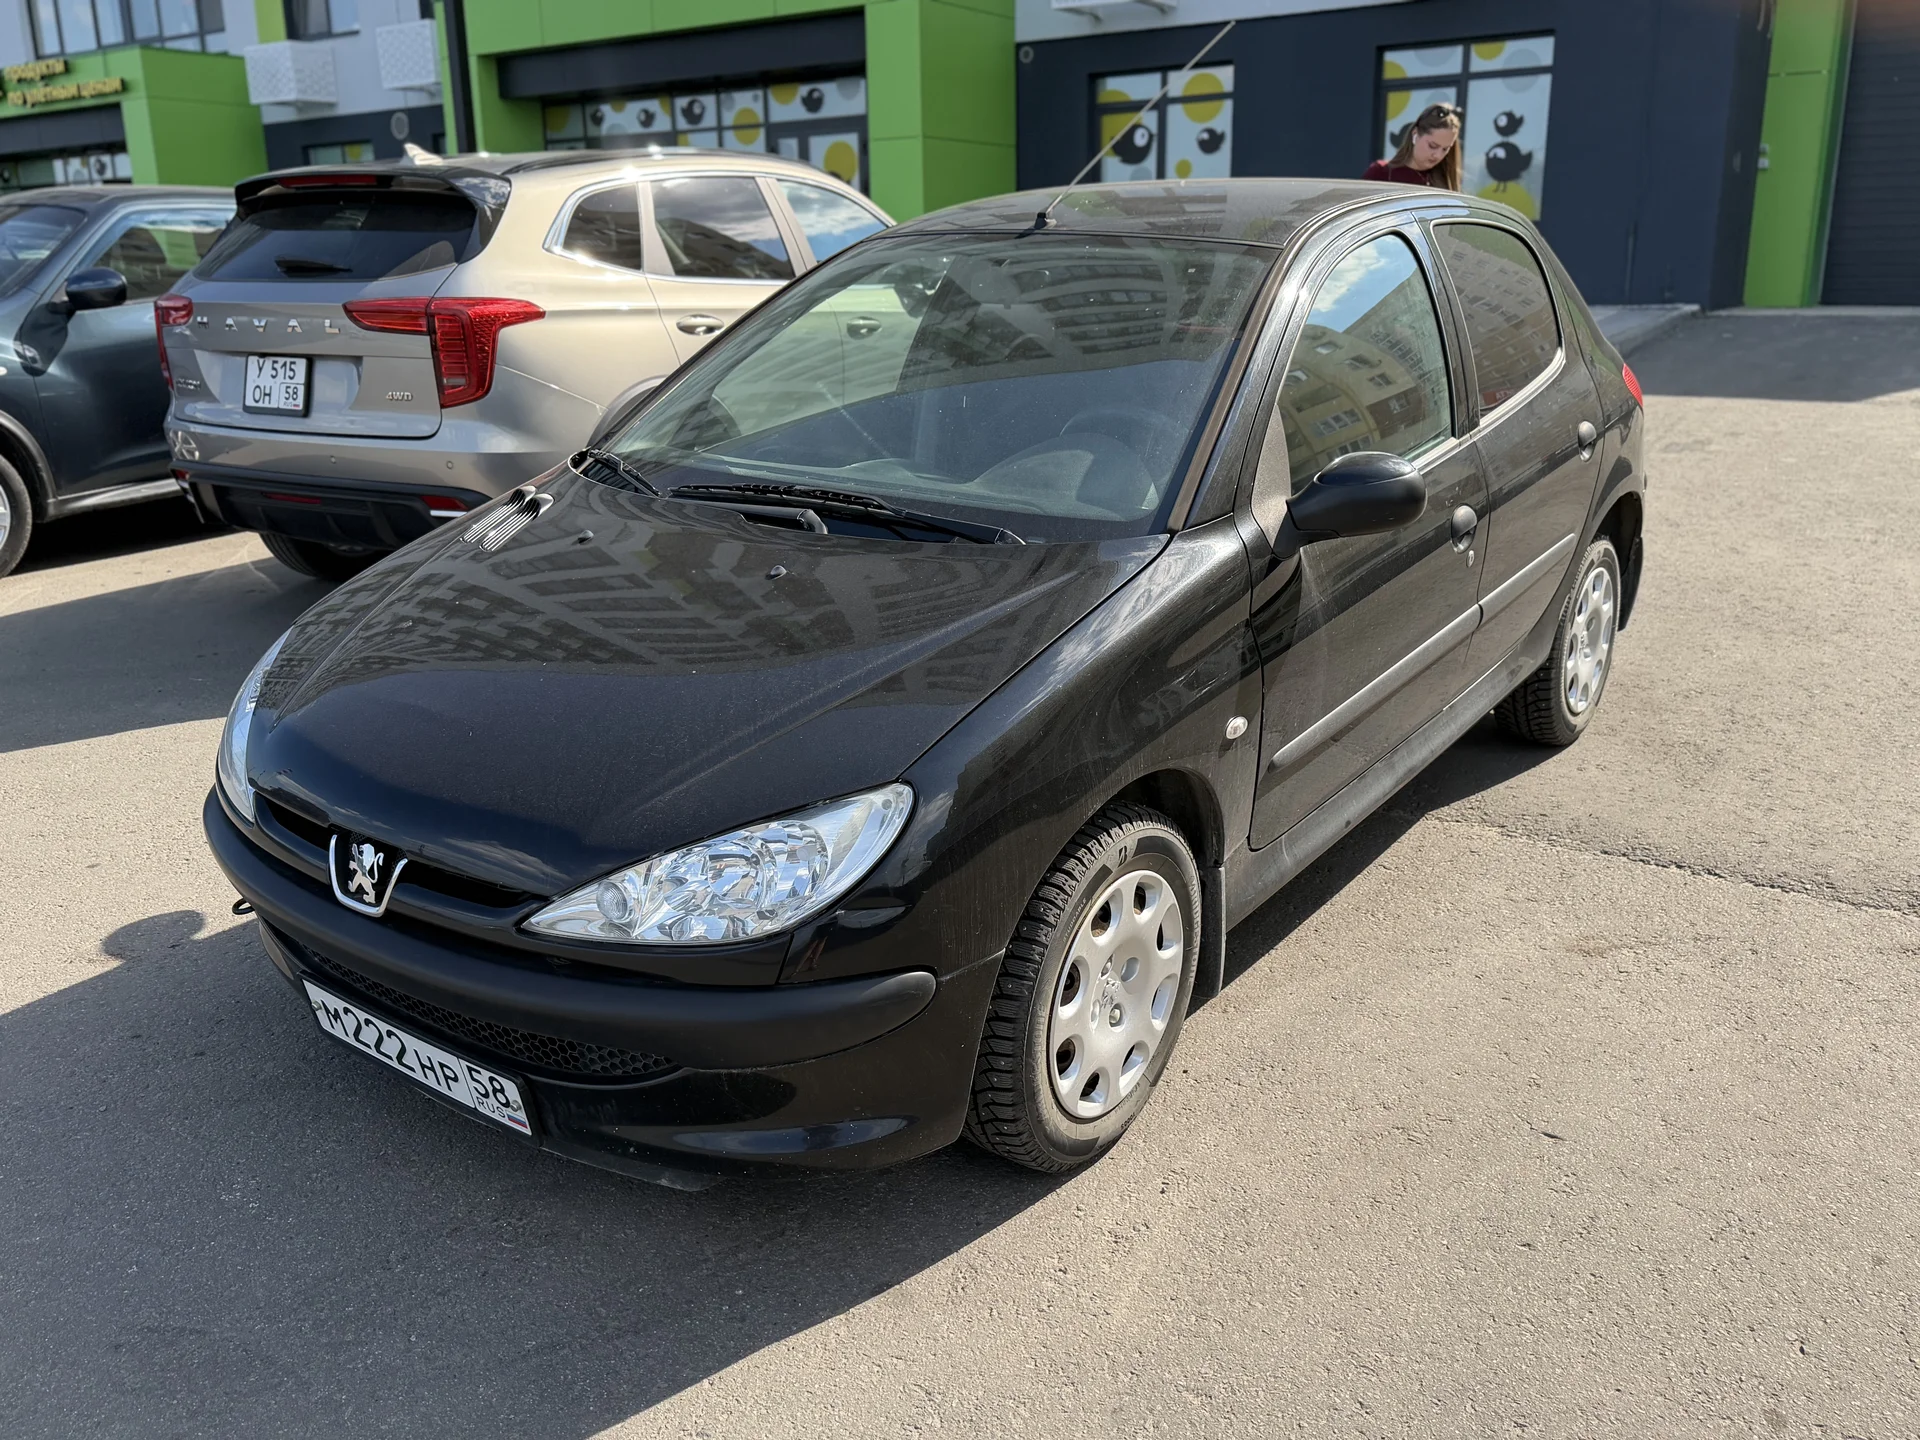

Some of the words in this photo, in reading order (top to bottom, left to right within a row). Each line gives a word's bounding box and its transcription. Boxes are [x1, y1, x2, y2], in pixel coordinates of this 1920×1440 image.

[197, 316, 340, 334] HAVAL
[270, 360, 296, 380] 515
[253, 384, 272, 404] ОН
[285, 386, 299, 401] 58
[386, 391, 413, 401] 4WD
[465, 1064, 511, 1108] 58
[476, 1097, 506, 1119] RUS
